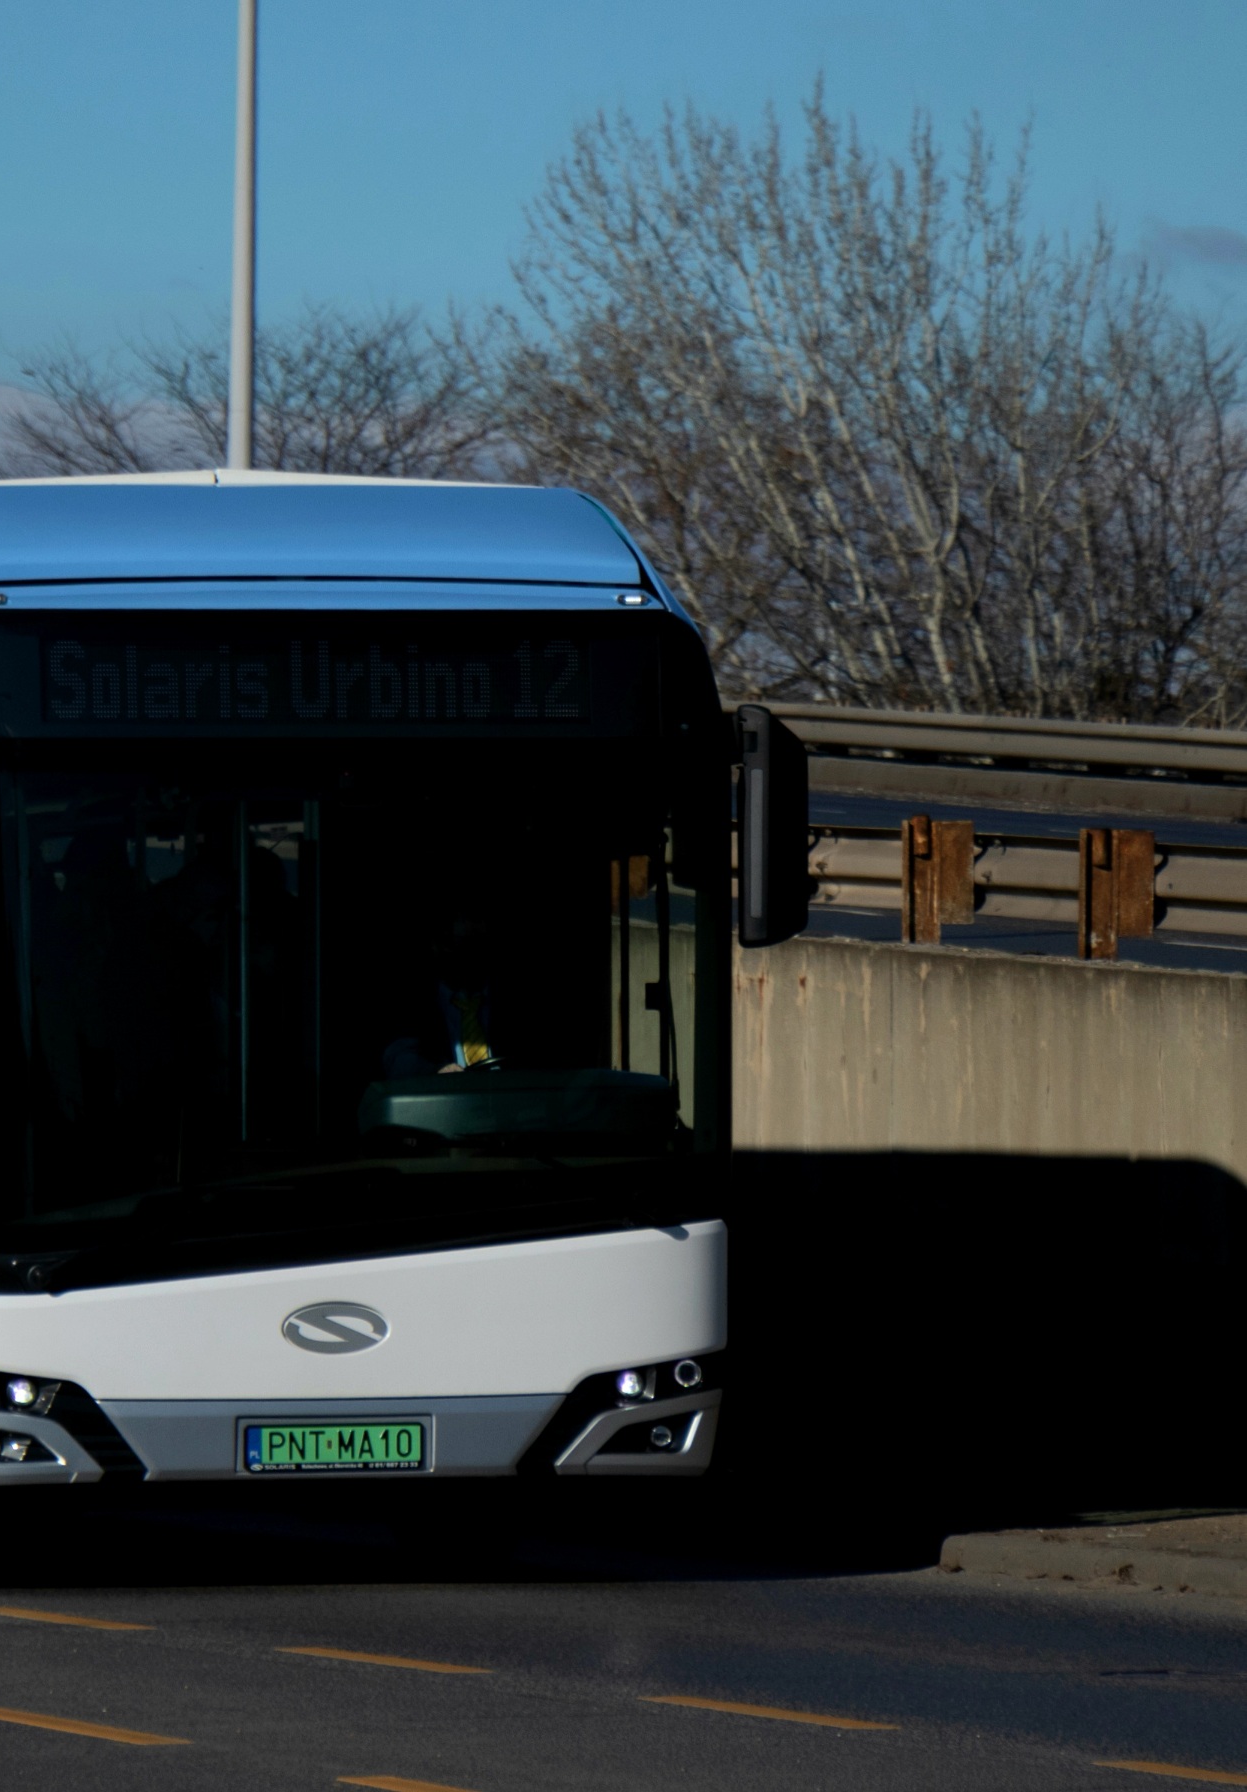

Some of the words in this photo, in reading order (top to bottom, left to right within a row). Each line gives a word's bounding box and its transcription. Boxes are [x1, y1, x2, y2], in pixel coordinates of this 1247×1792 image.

[50, 640, 268, 720] Solaris
[290, 640, 491, 719] Urbino
[513, 638, 579, 719] 12
[249, 1450, 261, 1460] PL
[268, 1430, 326, 1461] PNT
[338, 1428, 412, 1460] MA10
